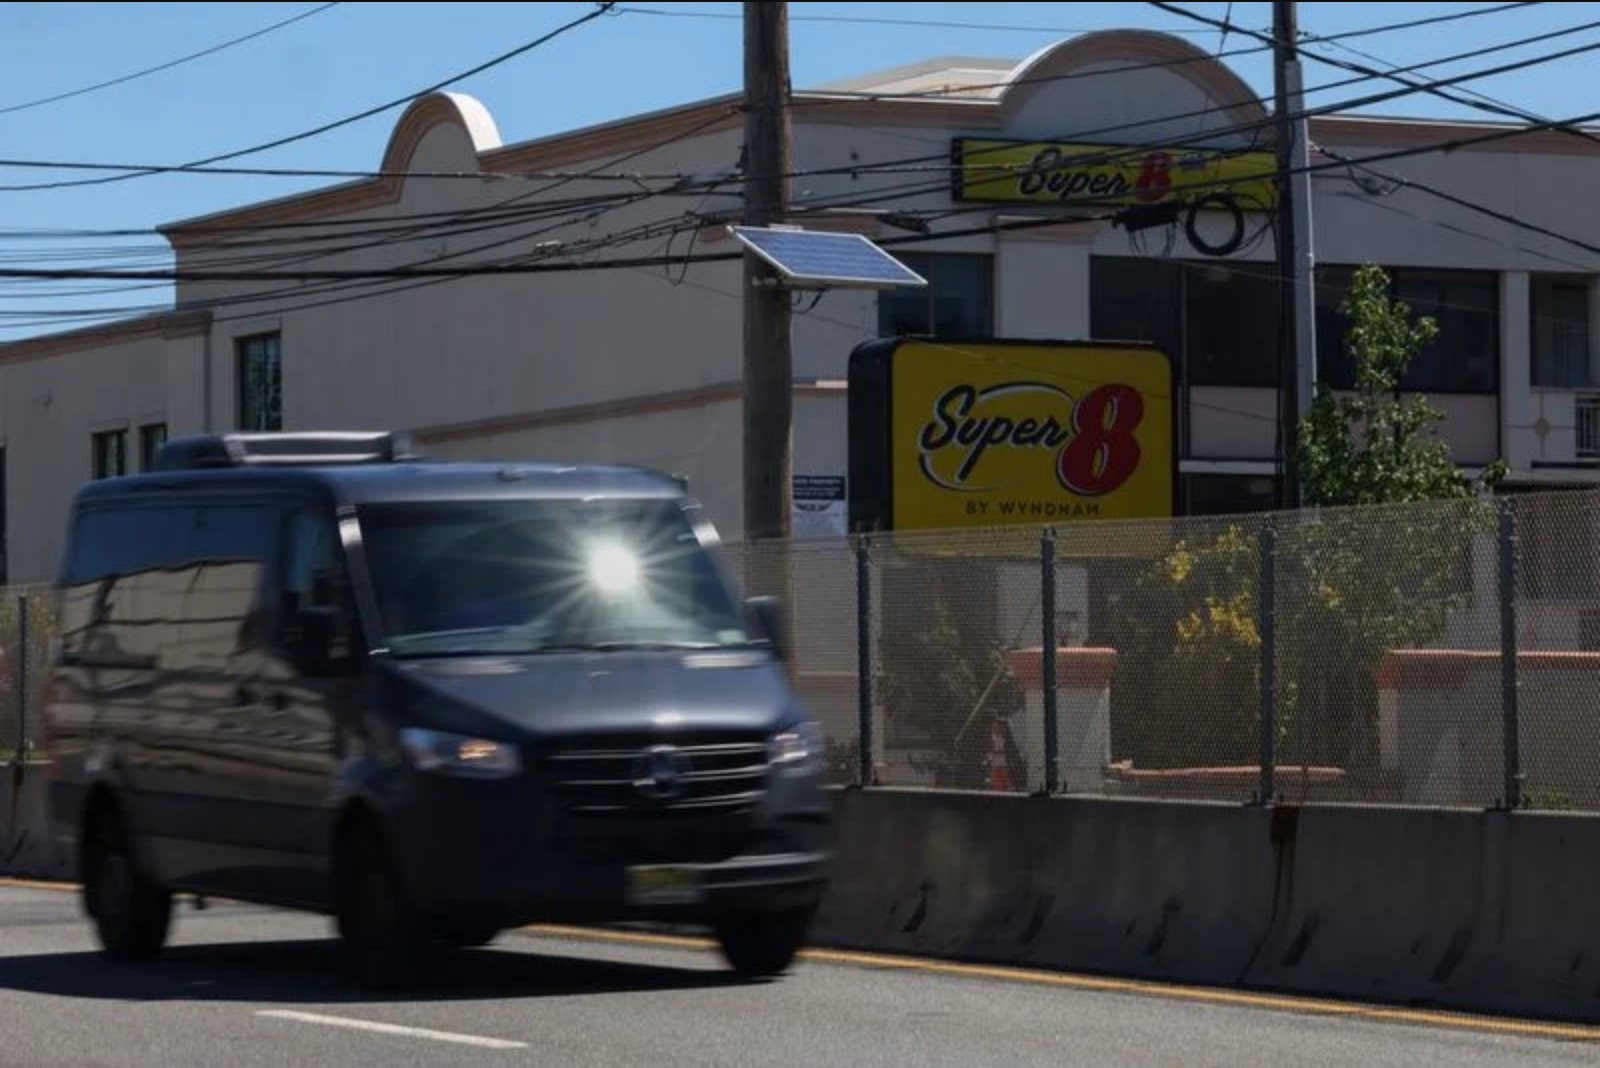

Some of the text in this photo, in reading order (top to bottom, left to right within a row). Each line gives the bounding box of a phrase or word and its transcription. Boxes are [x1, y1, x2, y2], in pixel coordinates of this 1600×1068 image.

[1019, 148, 1173, 203] Super 8
[918, 383, 1145, 498] Super 8
[965, 501, 1100, 516] BY WYNDHAM
